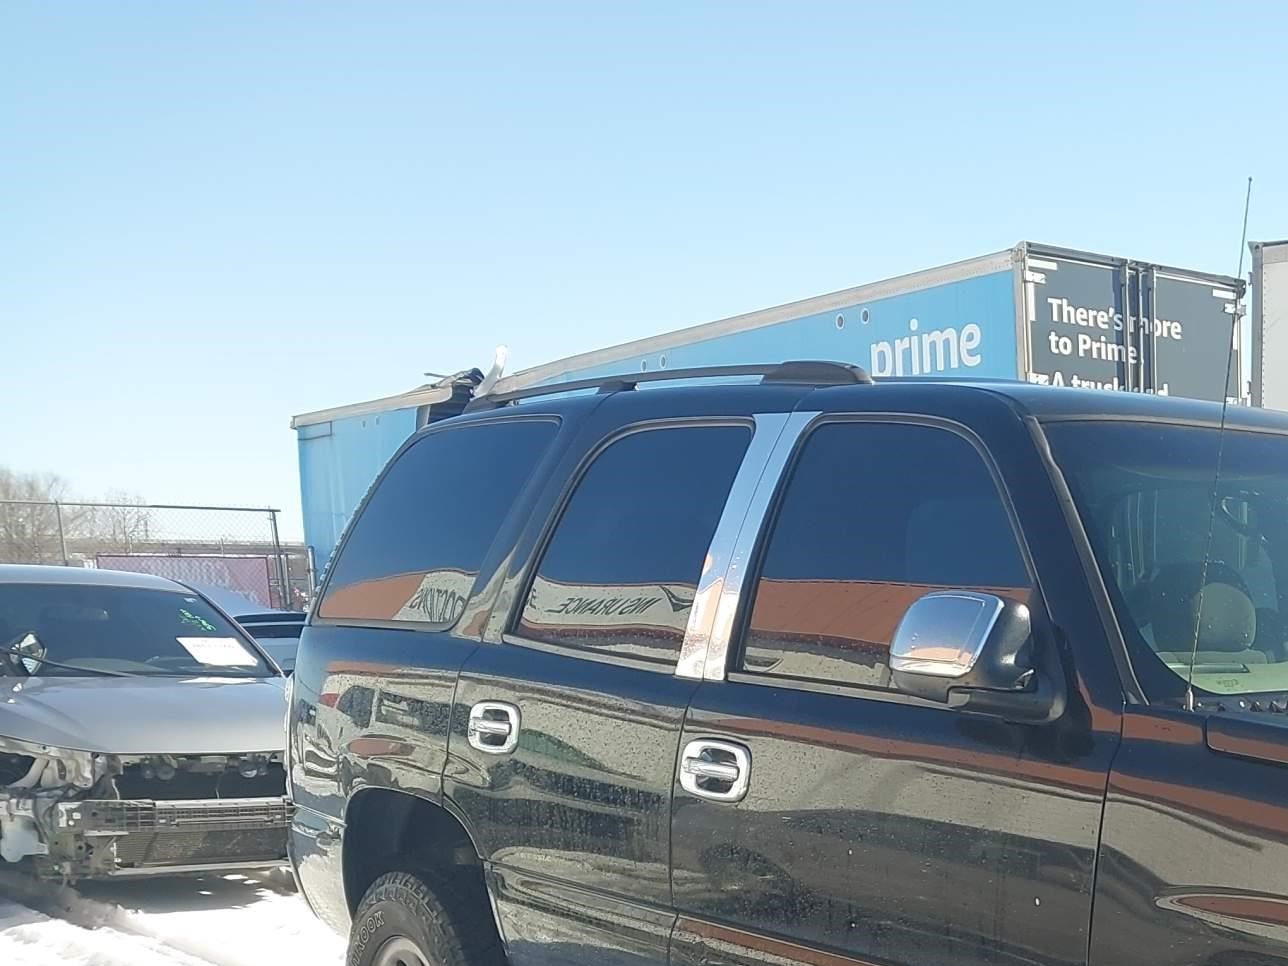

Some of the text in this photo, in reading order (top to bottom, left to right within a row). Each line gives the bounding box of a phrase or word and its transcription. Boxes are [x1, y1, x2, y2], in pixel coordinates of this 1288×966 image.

[1047, 297, 1183, 340] There's more
[870, 318, 982, 377] prime
[1048, 331, 1072, 356] to
